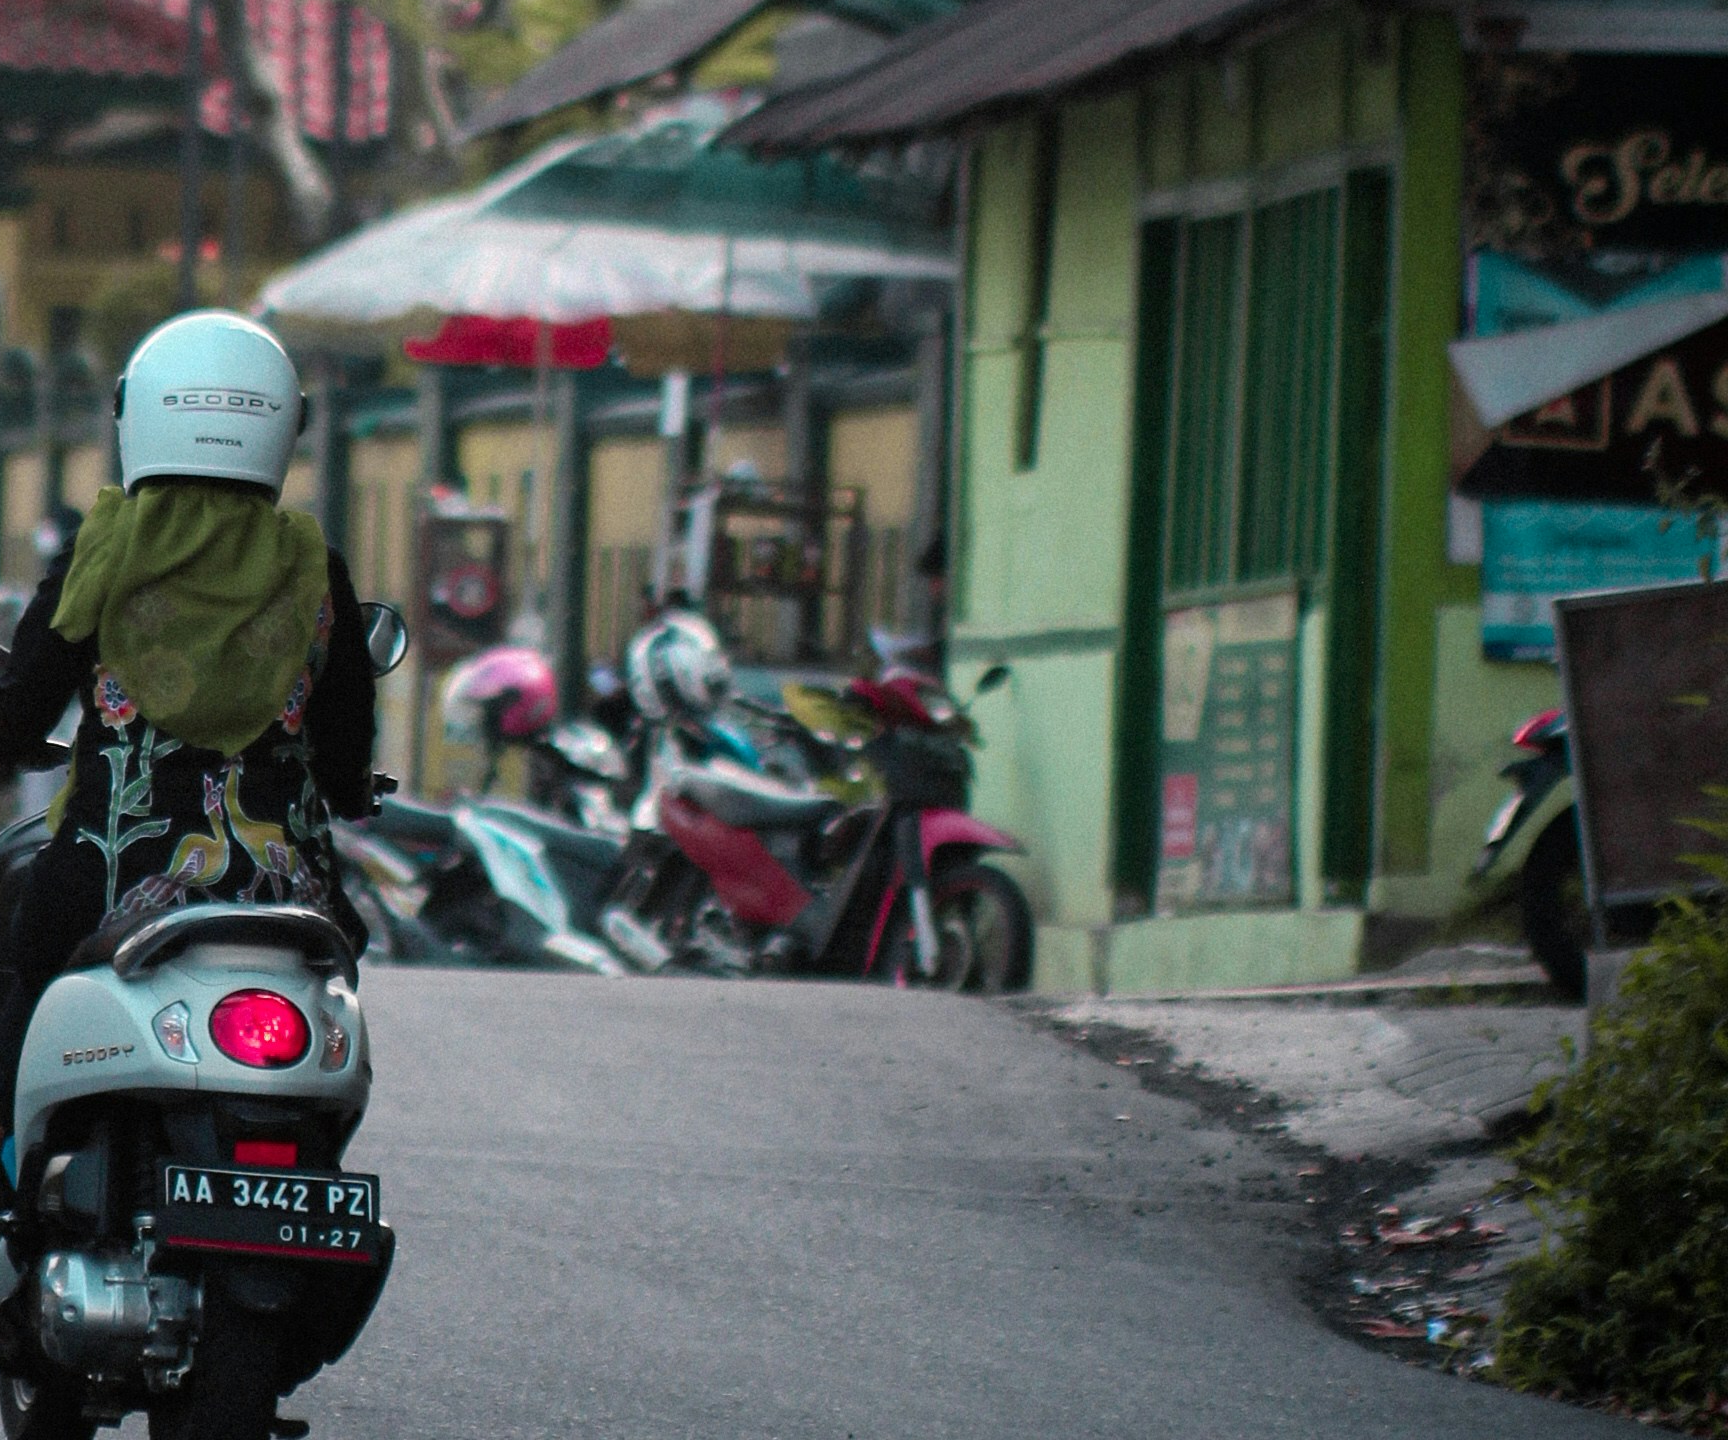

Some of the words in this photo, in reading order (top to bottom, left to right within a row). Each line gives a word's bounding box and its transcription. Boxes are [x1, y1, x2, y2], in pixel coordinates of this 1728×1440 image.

[163, 394, 281, 412] SCOOPY
[194, 436, 243, 448] HONDA
[62, 1044, 135, 1066] SCOOPY
[174, 1173, 213, 1204] AA
[233, 1179, 308, 1213] 3442
[328, 1185, 366, 1216] PZ
